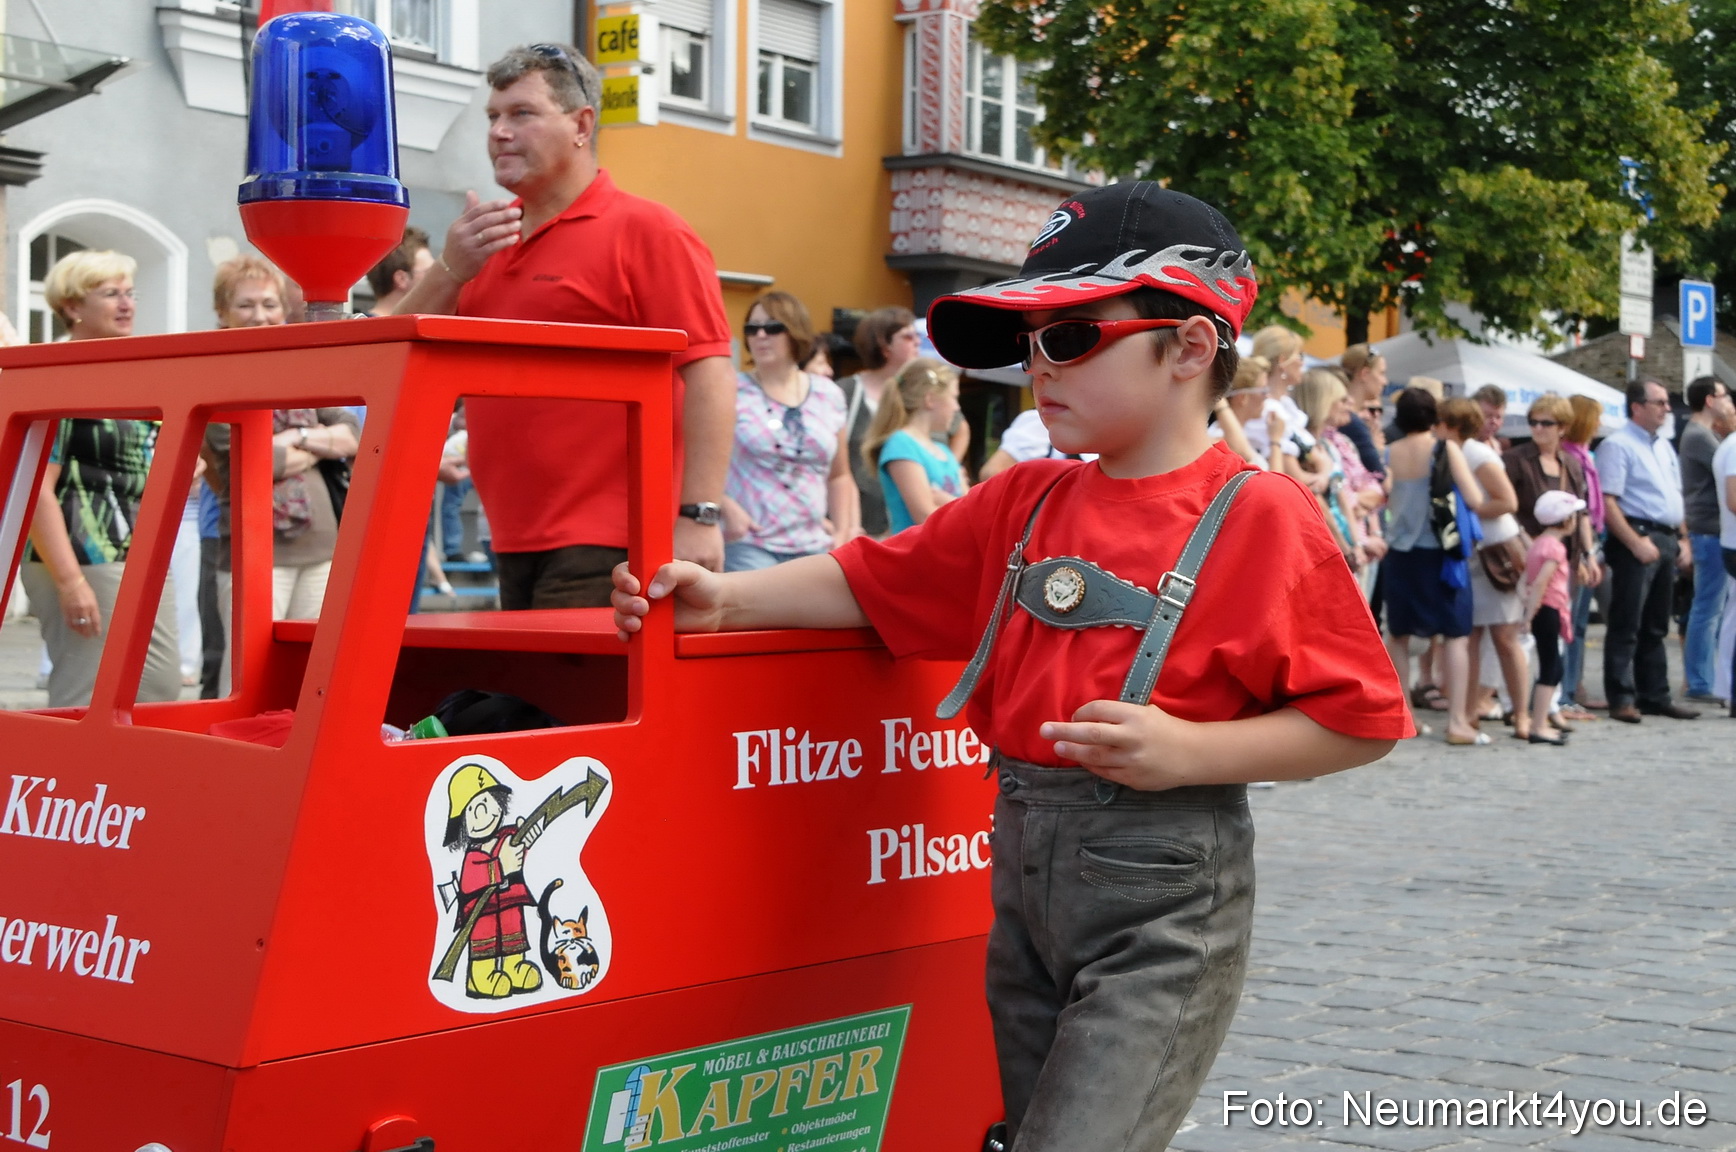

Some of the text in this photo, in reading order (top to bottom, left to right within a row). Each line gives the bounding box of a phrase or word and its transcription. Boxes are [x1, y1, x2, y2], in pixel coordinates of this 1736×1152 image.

[598, 20, 638, 53] café
[1687, 290, 1707, 339] P
[732, 726, 862, 790] Flitze
[0, 774, 146, 849] Kinder
[866, 814, 996, 885] Pilsac
[702, 1022, 892, 1077] MÖBEL & BAUSCHREINEREI
[0, 1078, 51, 1150] 12
[625, 1046, 884, 1152] KAPFER
[791, 1109, 857, 1135] Objektmöbel
[787, 1125, 872, 1152] Restaurierungen
